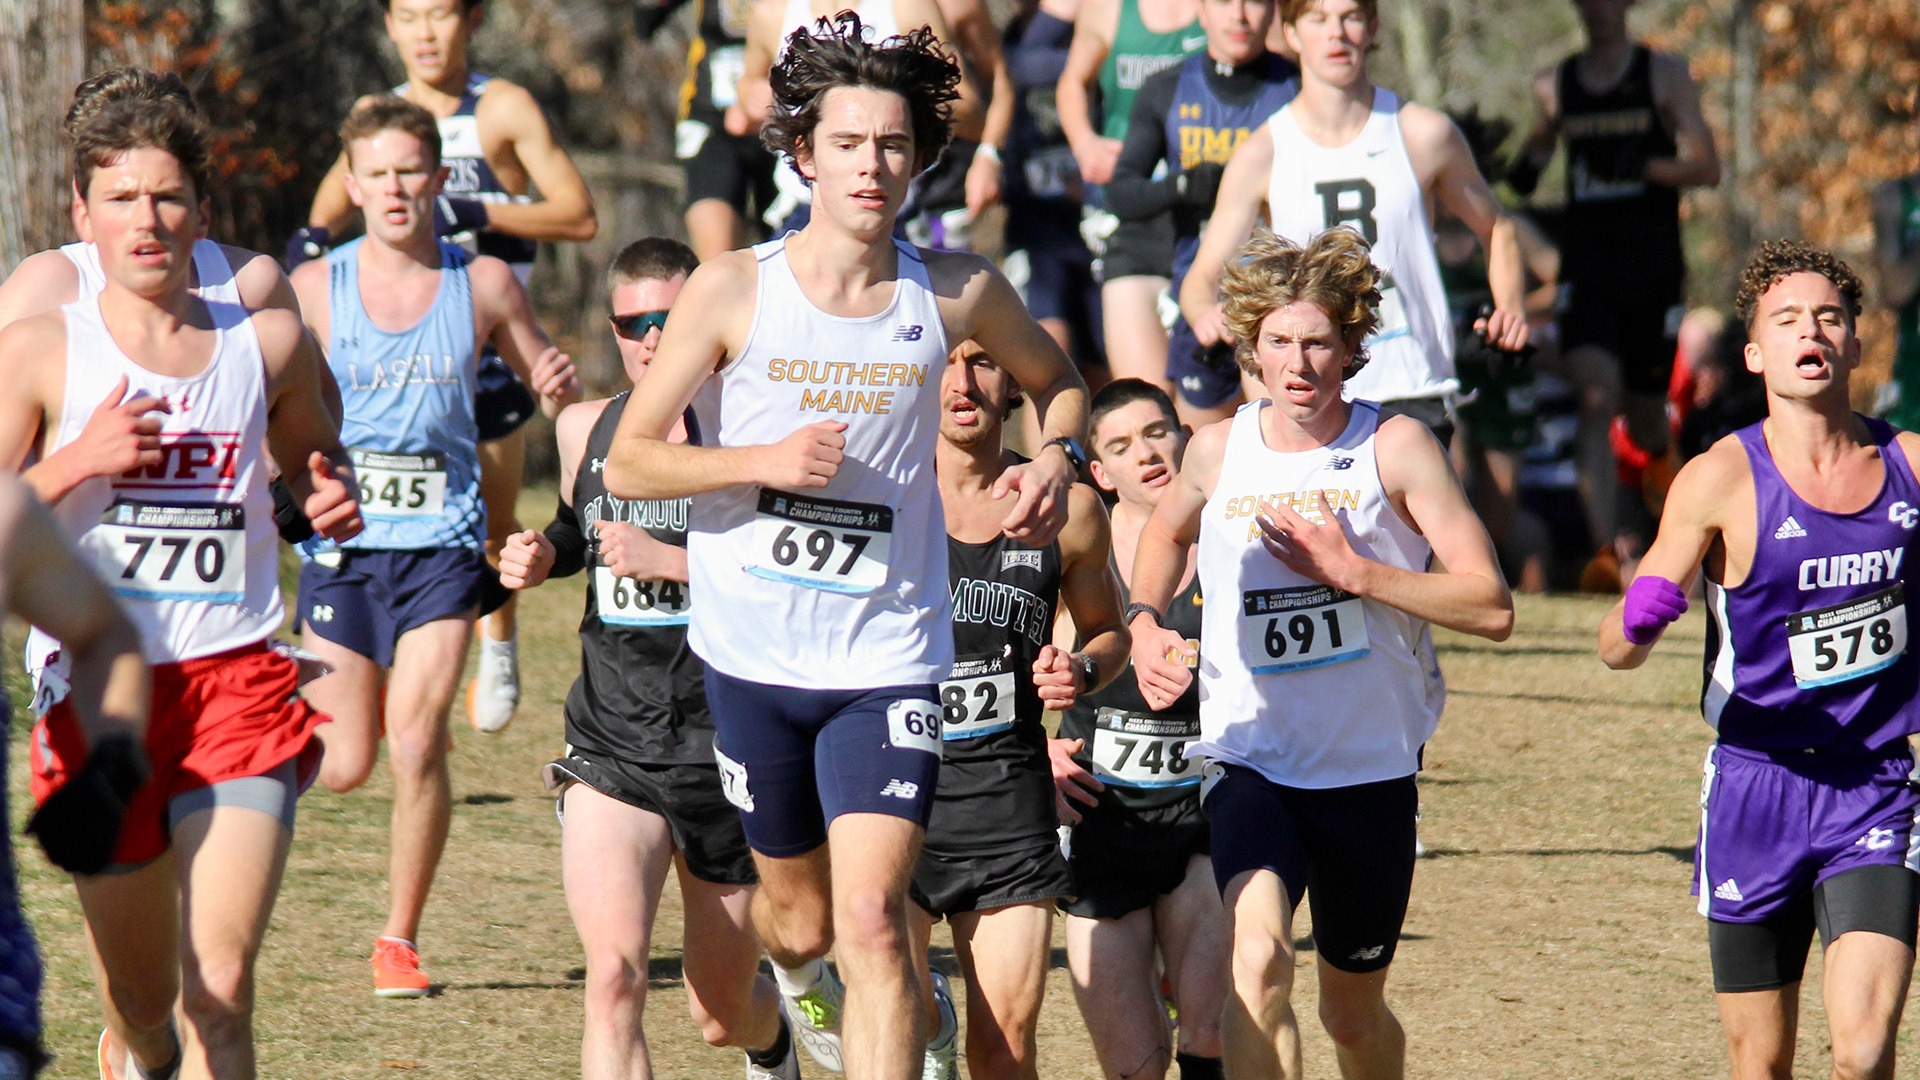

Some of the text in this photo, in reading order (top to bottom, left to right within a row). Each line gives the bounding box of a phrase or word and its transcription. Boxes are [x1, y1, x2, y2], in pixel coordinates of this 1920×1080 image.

[1315, 178, 1377, 246] B
[347, 353, 459, 391] LASELL
[767, 358, 928, 387] SOUTHERN
[799, 388, 894, 414] MAINE
[122, 442, 239, 479] WPI
[357, 473, 427, 509] 645
[137, 513, 219, 528] CHAMPIONSHIPS
[789, 507, 865, 526] CHAMPIONSHIPS
[1774, 528, 1807, 540] adidas
[121, 535, 224, 583] 770
[772, 525, 871, 575] 697
[1798, 546, 1904, 591] CURRY
[613, 577, 684, 611] 684
[1269, 592, 1332, 610] CHAMPIONSHIPS
[1264, 608, 1342, 658] 691
[1817, 603, 1881, 629] CHAMPIONSHIPS
[1814, 619, 1893, 671] 578
[941, 681, 998, 724] 82
[905, 711, 942, 740] 69
[1124, 722, 1187, 734] CHAMPIONSHIPS
[1111, 736, 1190, 774] 748
